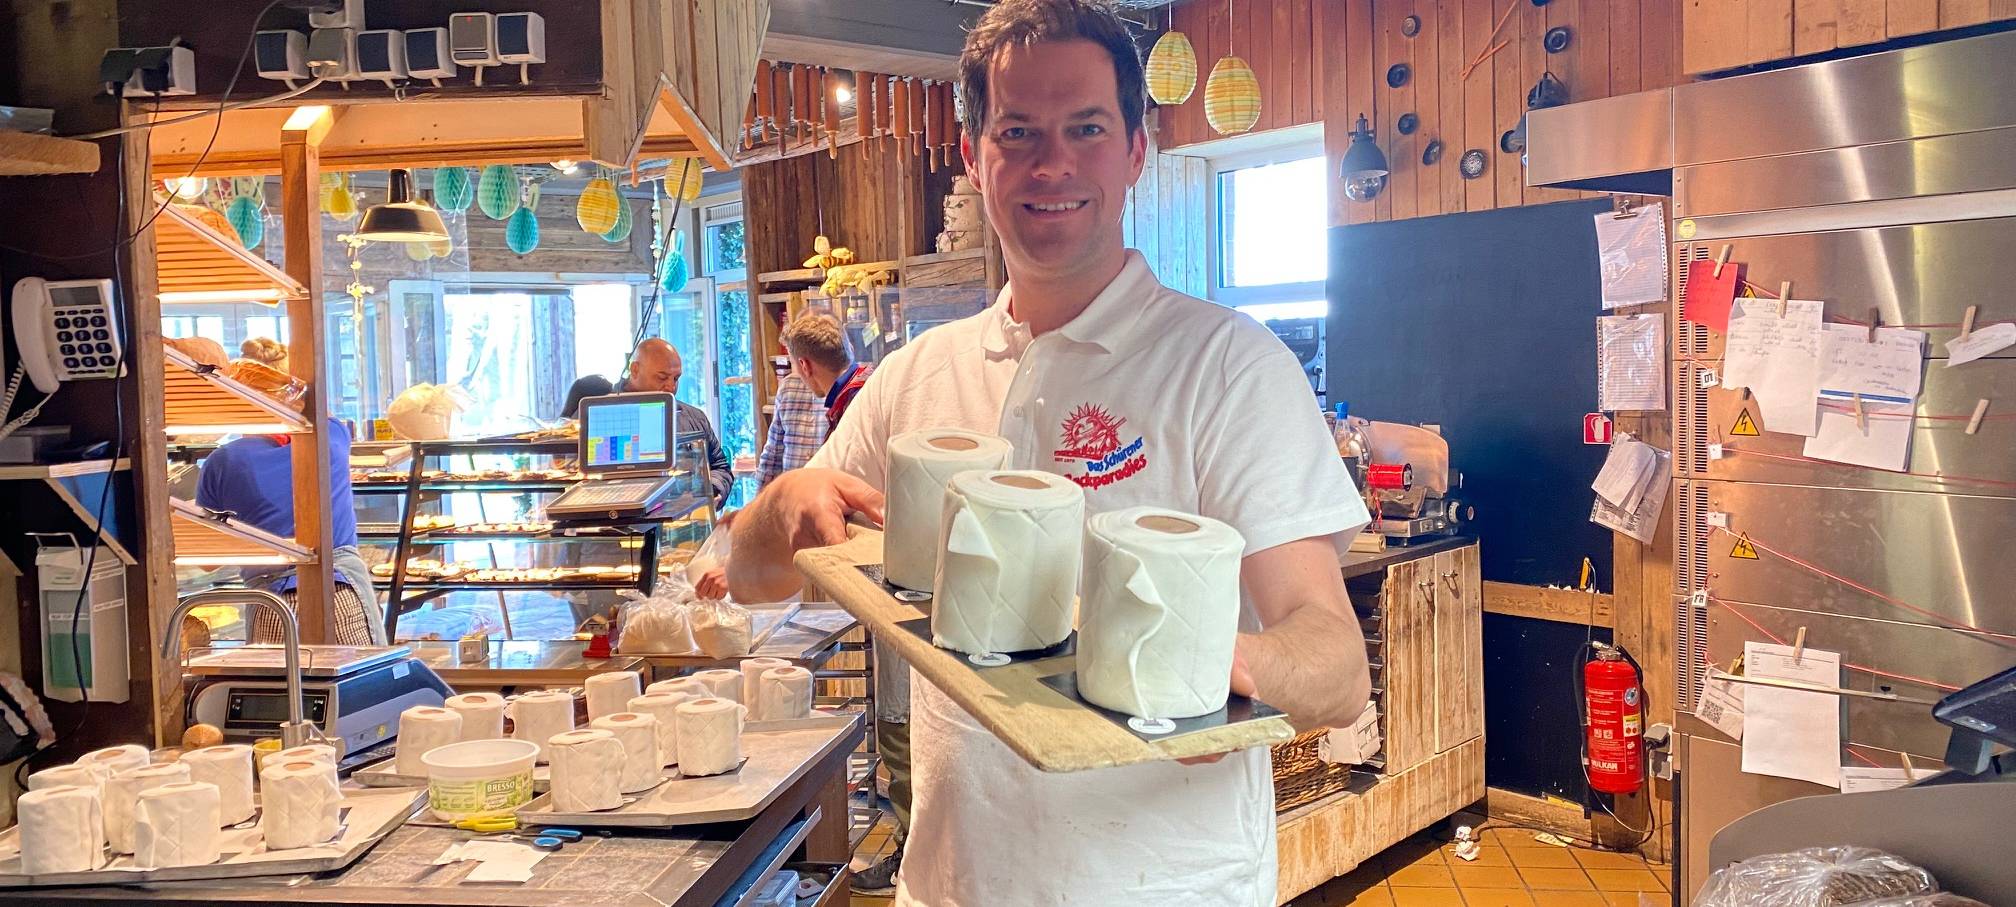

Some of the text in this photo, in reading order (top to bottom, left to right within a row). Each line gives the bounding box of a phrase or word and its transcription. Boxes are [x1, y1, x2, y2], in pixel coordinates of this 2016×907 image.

[1086, 460, 1104, 472] Das
[1103, 436, 1143, 471] Schürener
[1591, 759, 1618, 770] VULKAN
[487, 780, 515, 793] BRESSO
